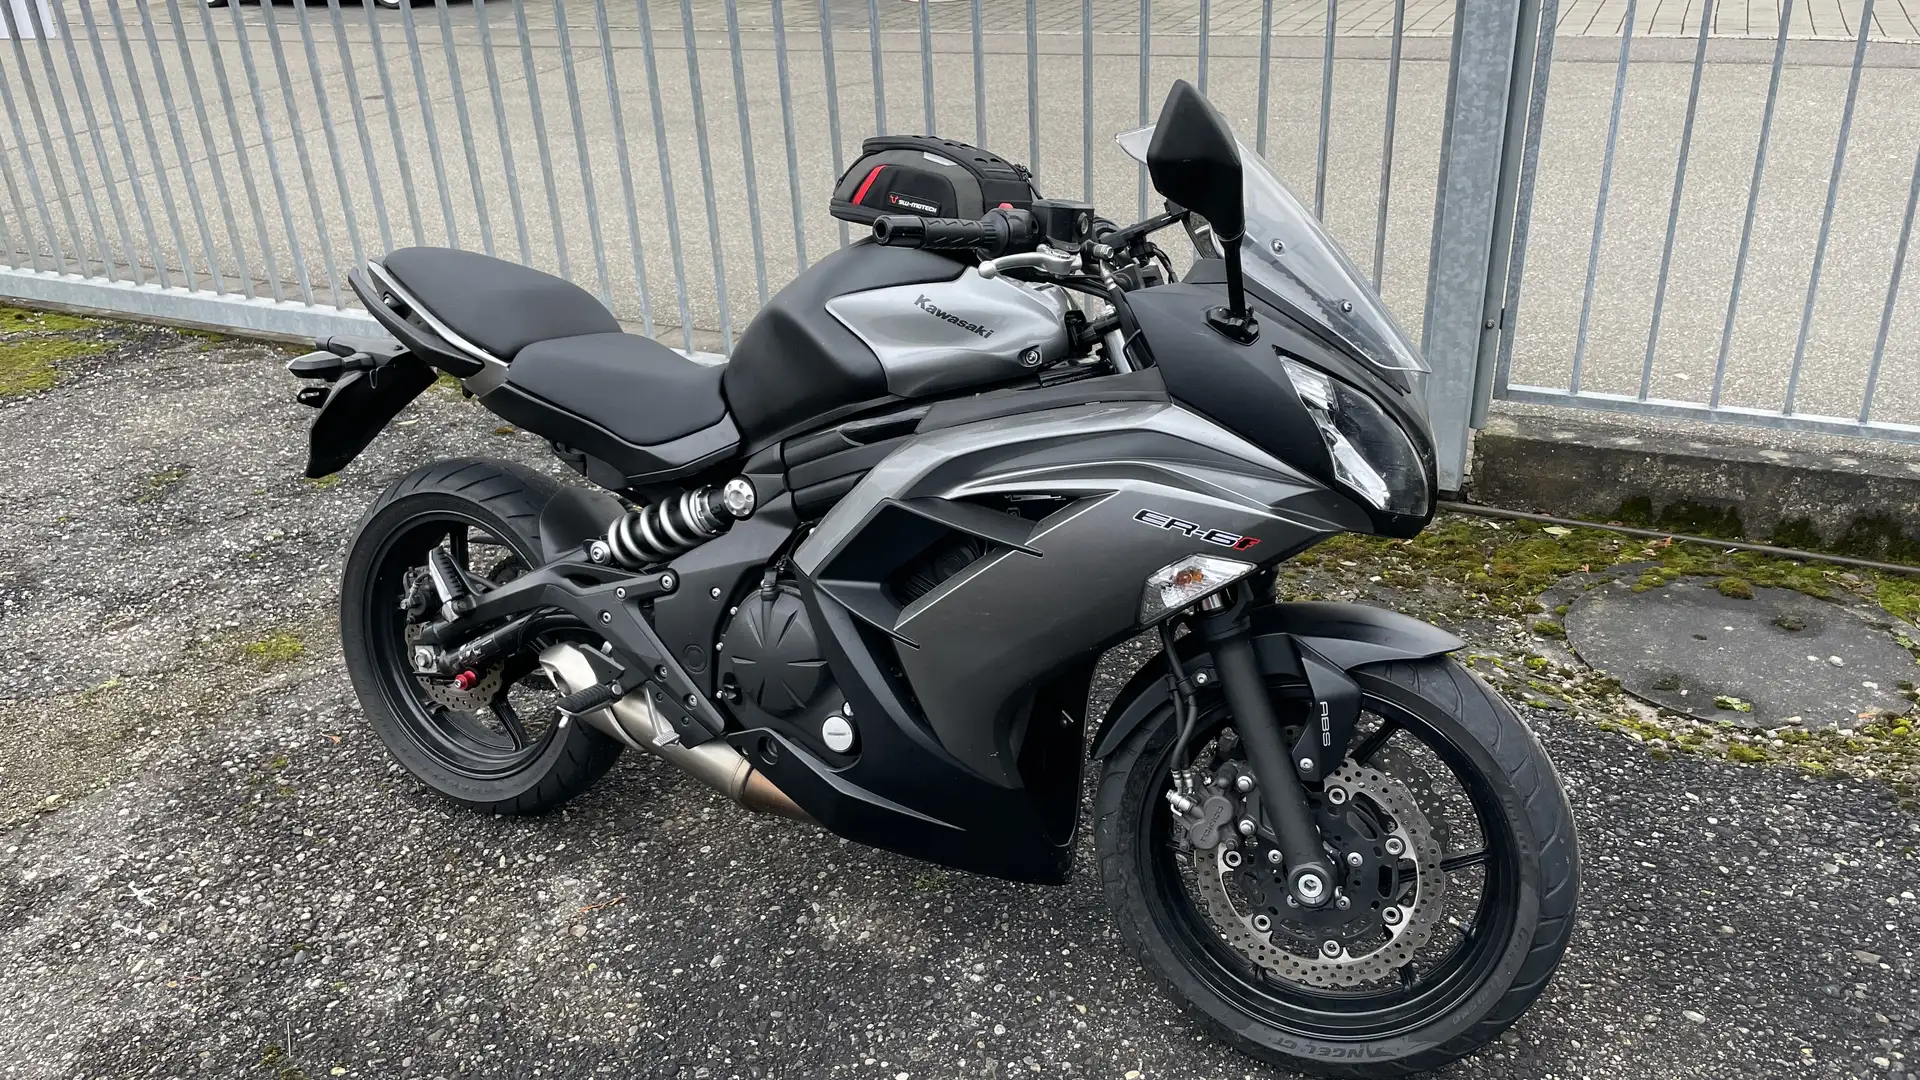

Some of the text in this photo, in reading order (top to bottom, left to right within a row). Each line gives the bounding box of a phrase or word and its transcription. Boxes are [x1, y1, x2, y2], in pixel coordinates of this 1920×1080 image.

[914, 294, 994, 339] Kawasaki
[1319, 701, 1331, 747] ABS
[1200, 805, 1224, 841] TOKICO
